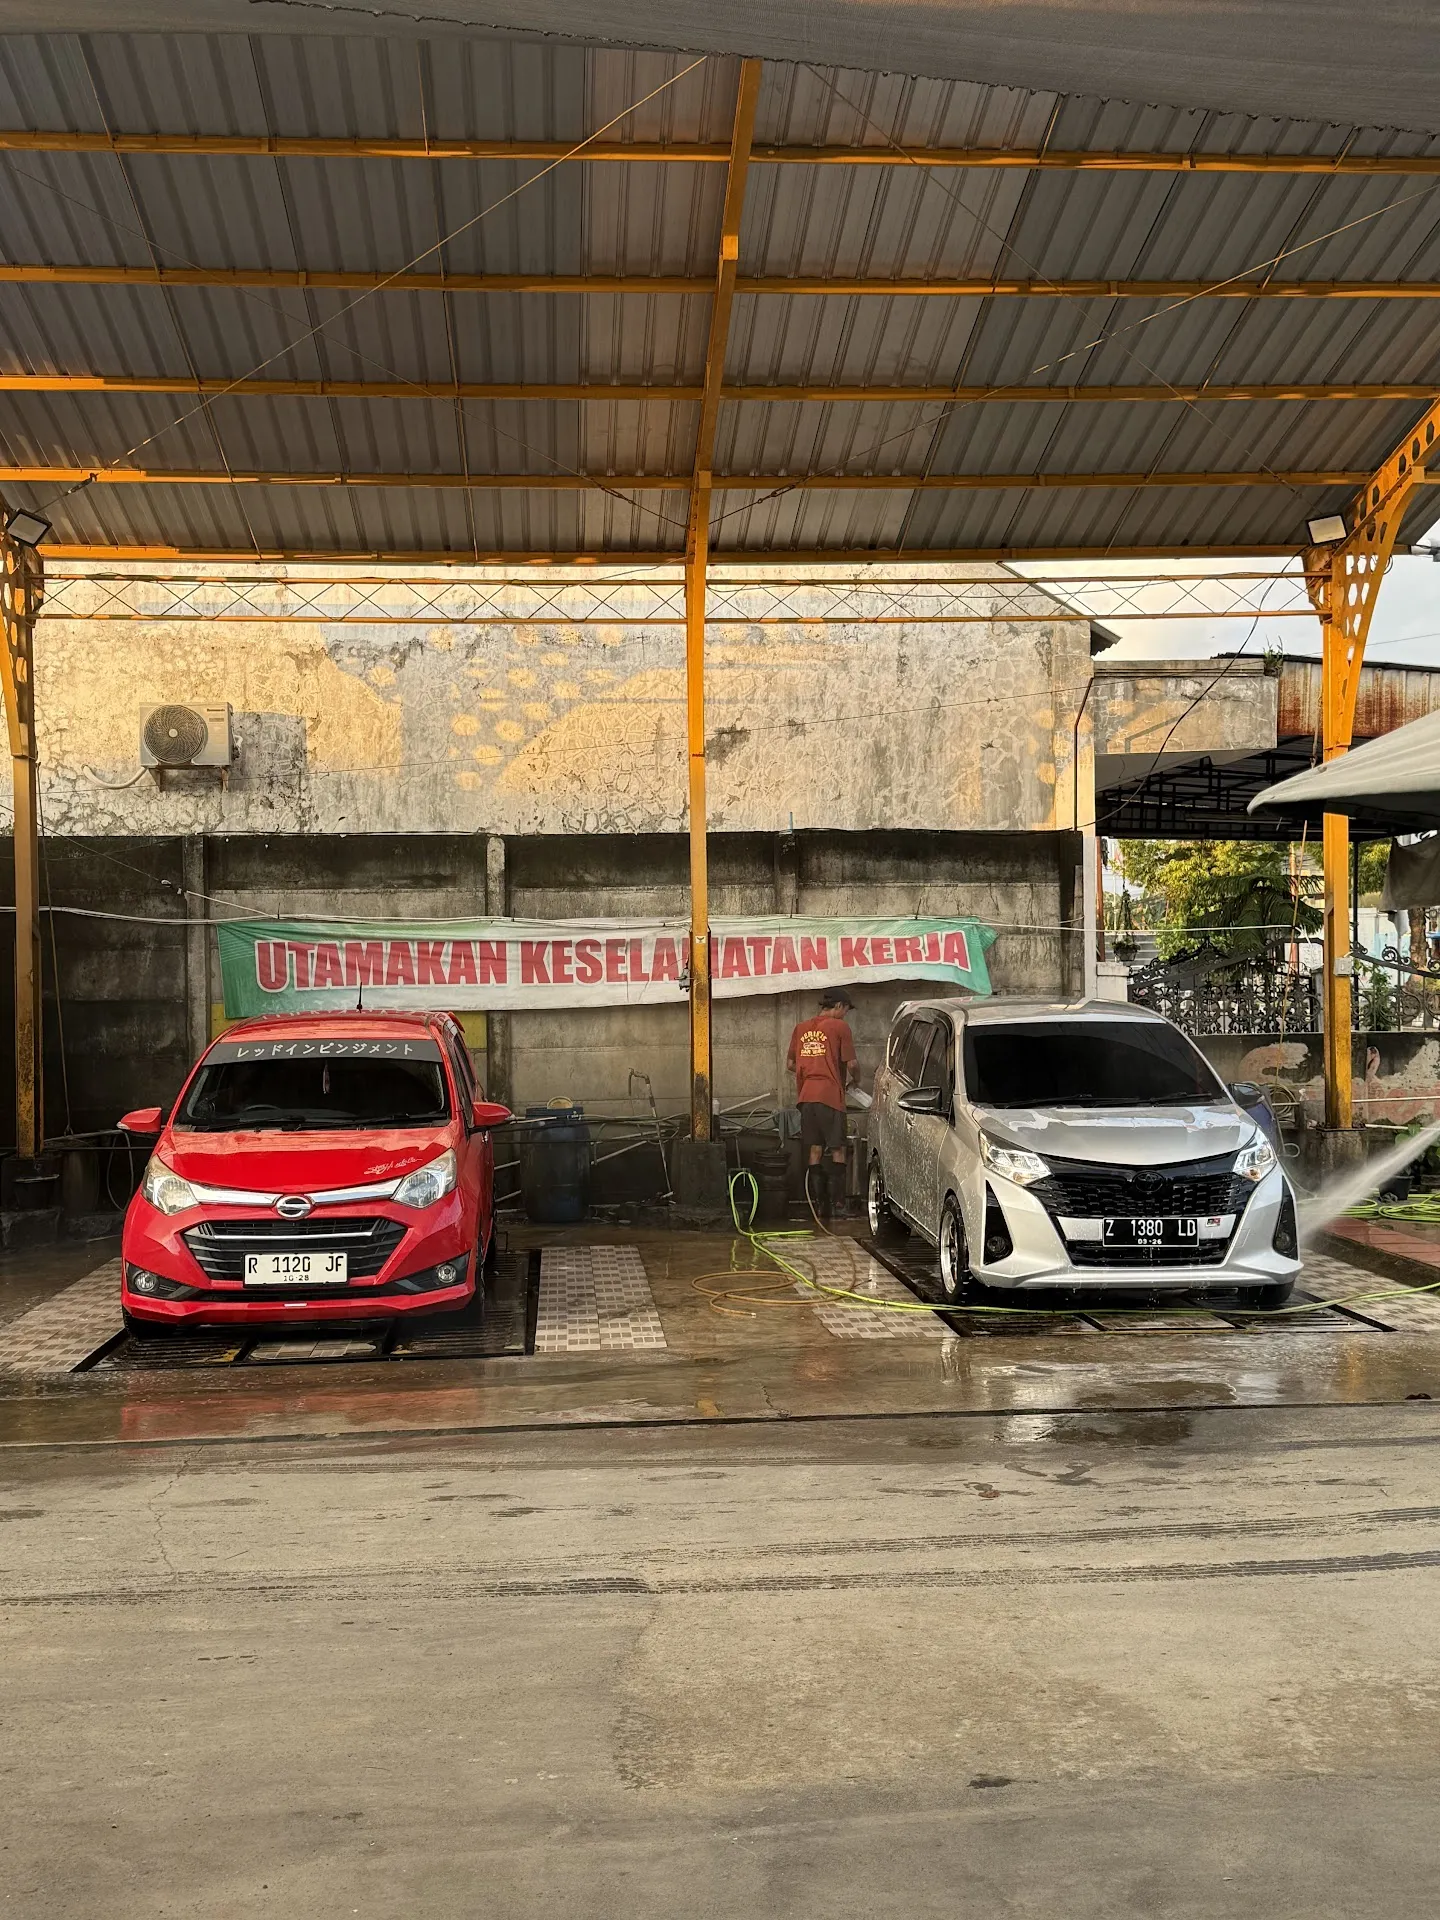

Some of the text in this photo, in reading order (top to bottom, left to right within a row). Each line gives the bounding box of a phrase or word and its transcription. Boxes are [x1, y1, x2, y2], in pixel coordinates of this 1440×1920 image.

[255, 940, 507, 991] UTAMAKAN
[841, 930, 973, 972] KERJA
[1105, 1219, 1114, 1236] Z
[1130, 1219, 1163, 1236] 1380
[1178, 1219, 1196, 1236] LD
[249, 1256, 344, 1273] R 1120 JF
